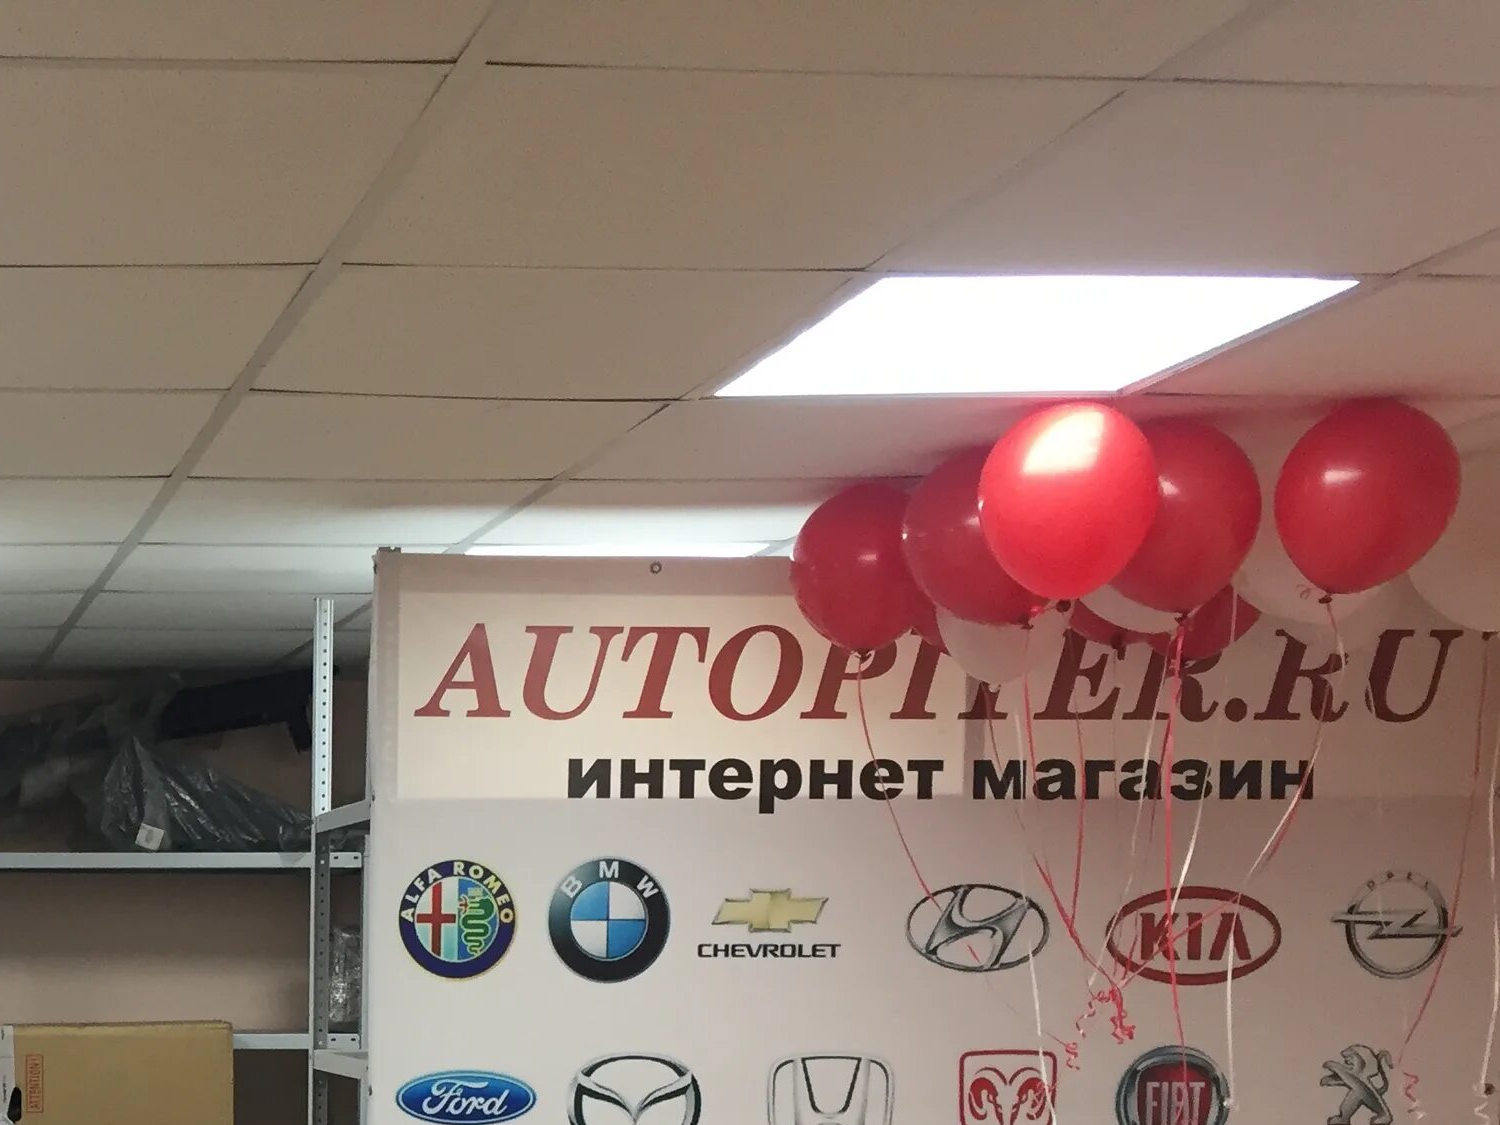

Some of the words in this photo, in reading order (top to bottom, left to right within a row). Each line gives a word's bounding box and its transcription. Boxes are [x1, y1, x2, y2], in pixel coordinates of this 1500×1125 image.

[568, 757, 944, 814] интернет
[972, 757, 1315, 802] магазин
[400, 867, 442, 923] ALFA
[452, 860, 514, 925] ROMEO
[562, 860, 660, 900] BMW
[697, 942, 841, 959] CHEVROLET
[1139, 912, 1252, 962] KIA
[421, 1079, 509, 1117] Ford
